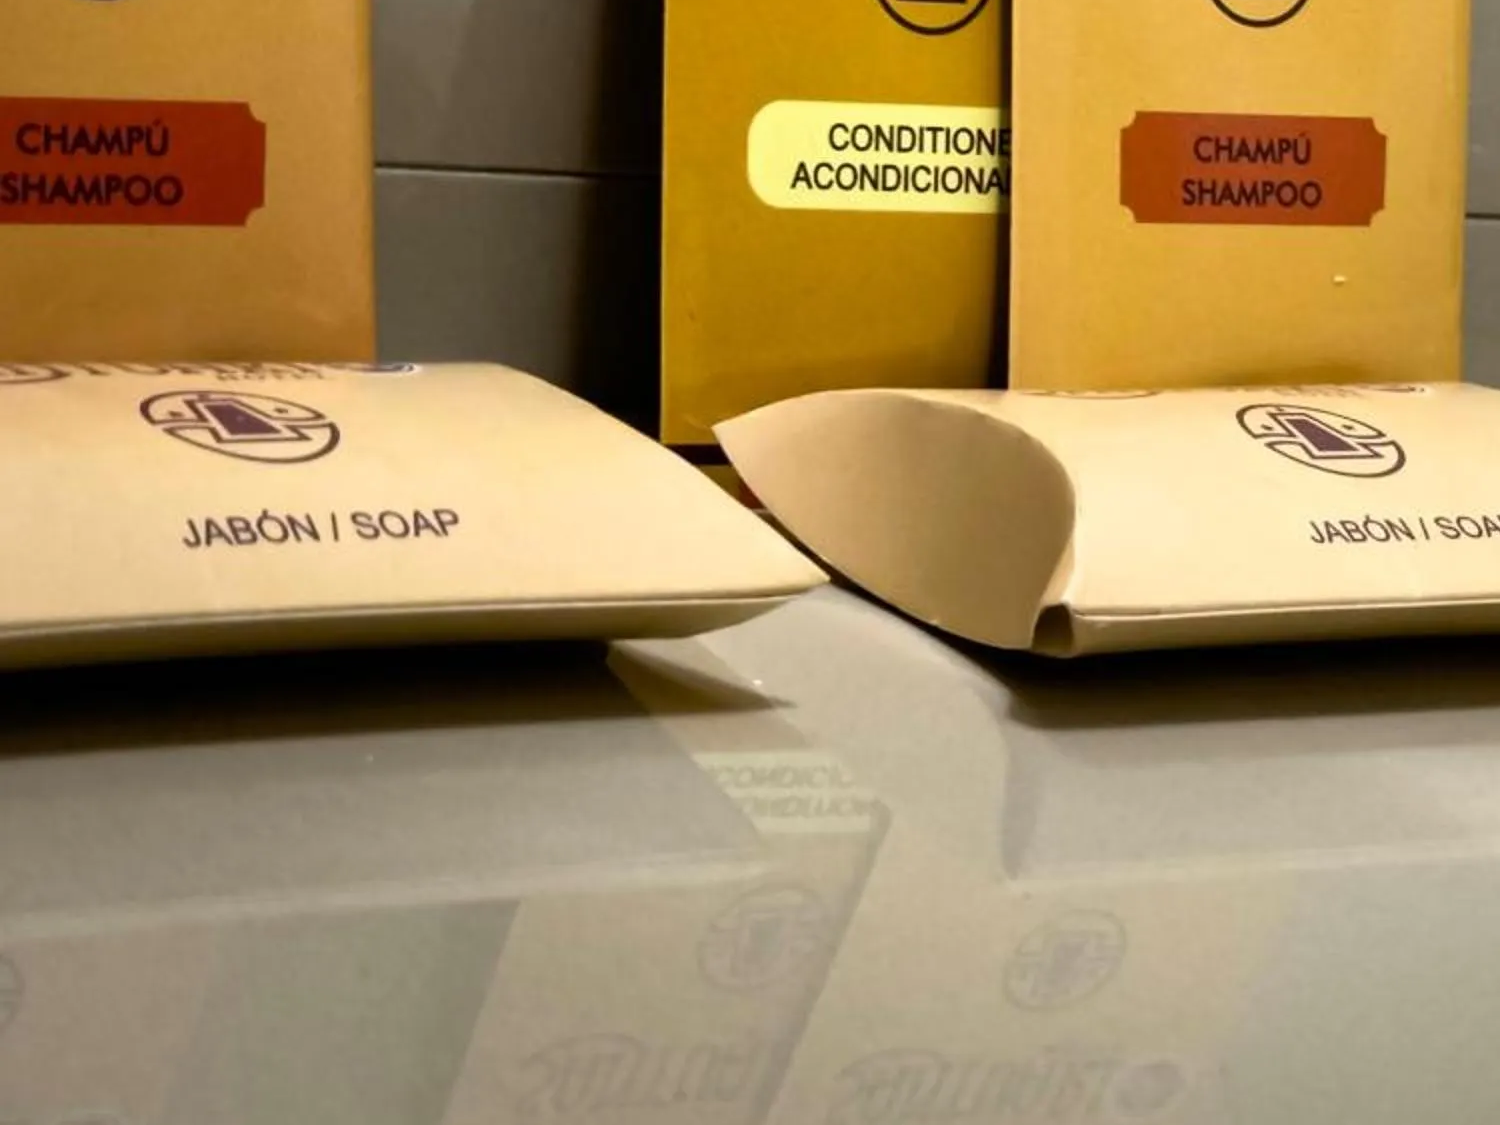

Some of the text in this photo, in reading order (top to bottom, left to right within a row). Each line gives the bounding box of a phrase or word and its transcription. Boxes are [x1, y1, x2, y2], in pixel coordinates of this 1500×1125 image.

[15, 119, 170, 157] CHAMPÚ
[1192, 131, 1312, 165] CHAMPÚ
[0, 172, 184, 207] SHAMPOO
[790, 160, 1012, 196] ACONDICIONA
[1181, 177, 1324, 210] SHAMPOO
[182, 508, 322, 549] JABÓN
[350, 508, 461, 541] SOAP
[1311, 514, 1414, 544] JABÓN
